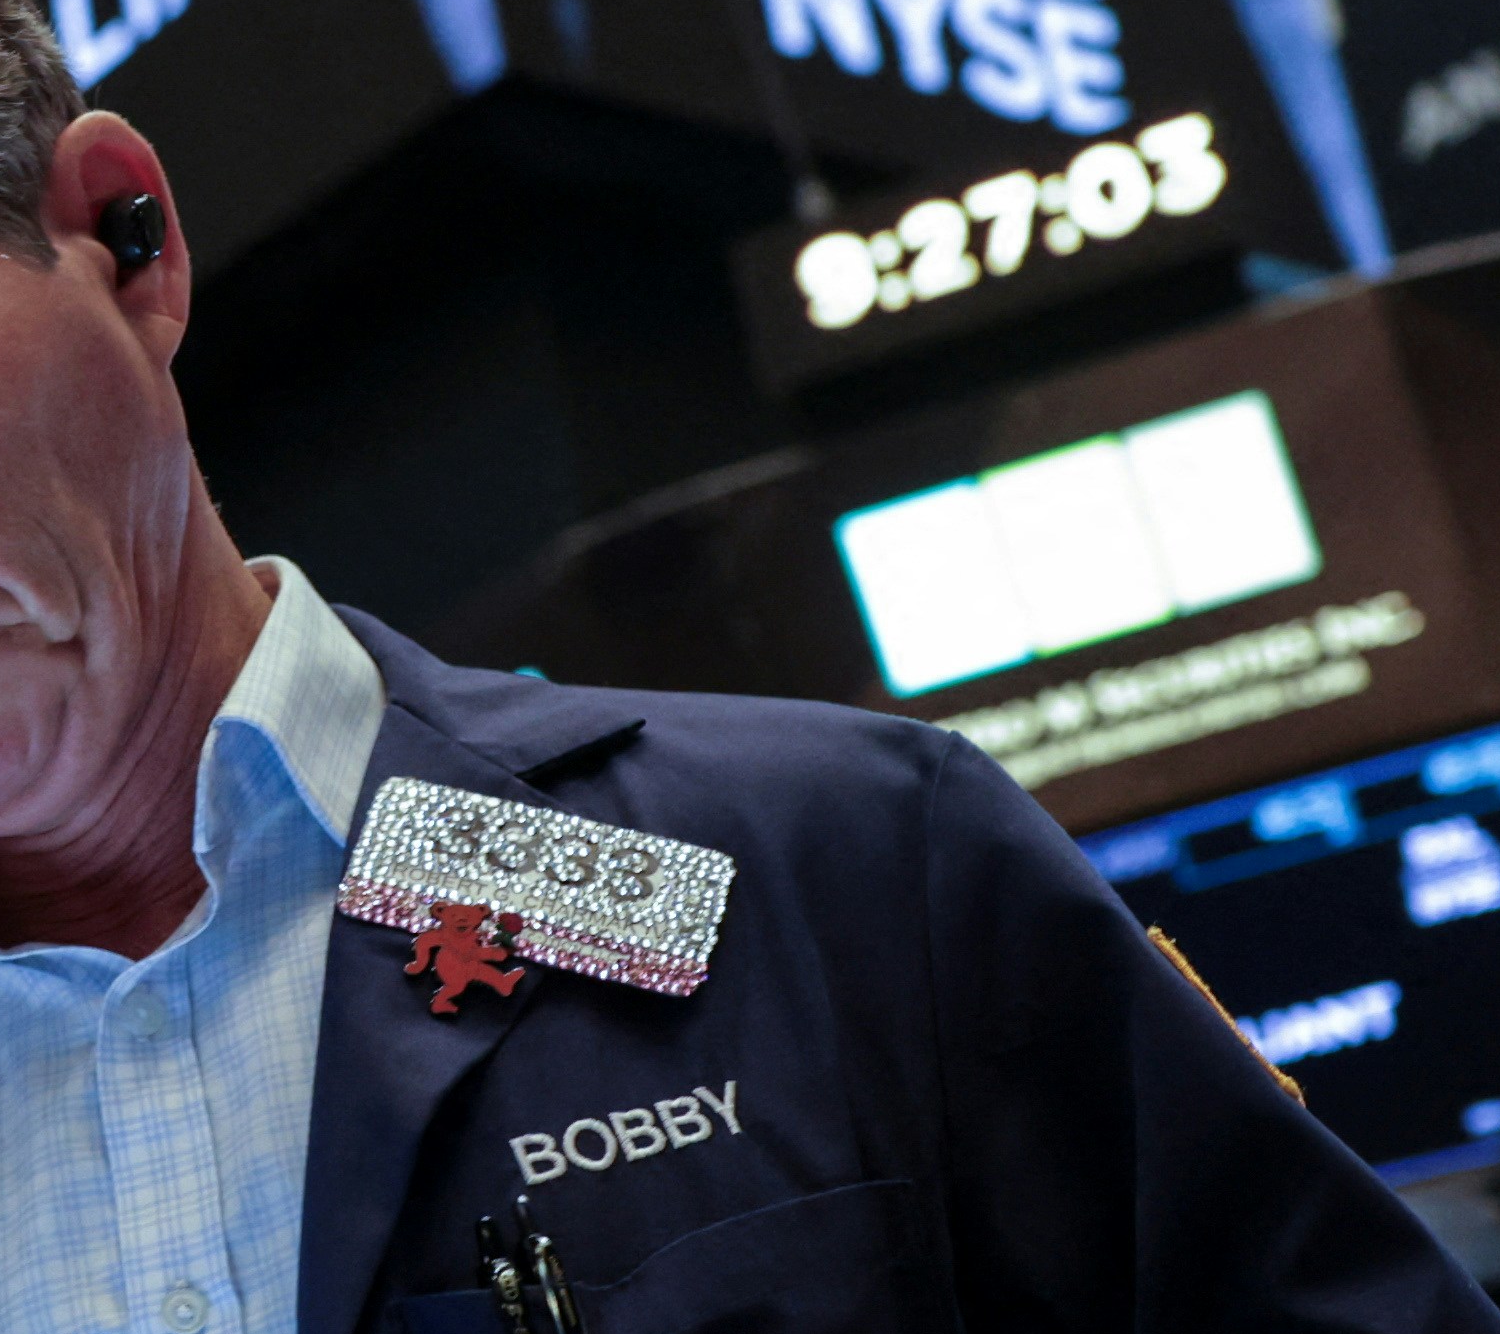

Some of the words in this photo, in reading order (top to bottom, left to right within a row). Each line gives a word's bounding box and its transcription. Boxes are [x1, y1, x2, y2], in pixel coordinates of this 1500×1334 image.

[795, 112, 1227, 329] 9:27:03
[392, 865, 489, 897] ROBERT
[509, 1080, 744, 1185] BOBBY
